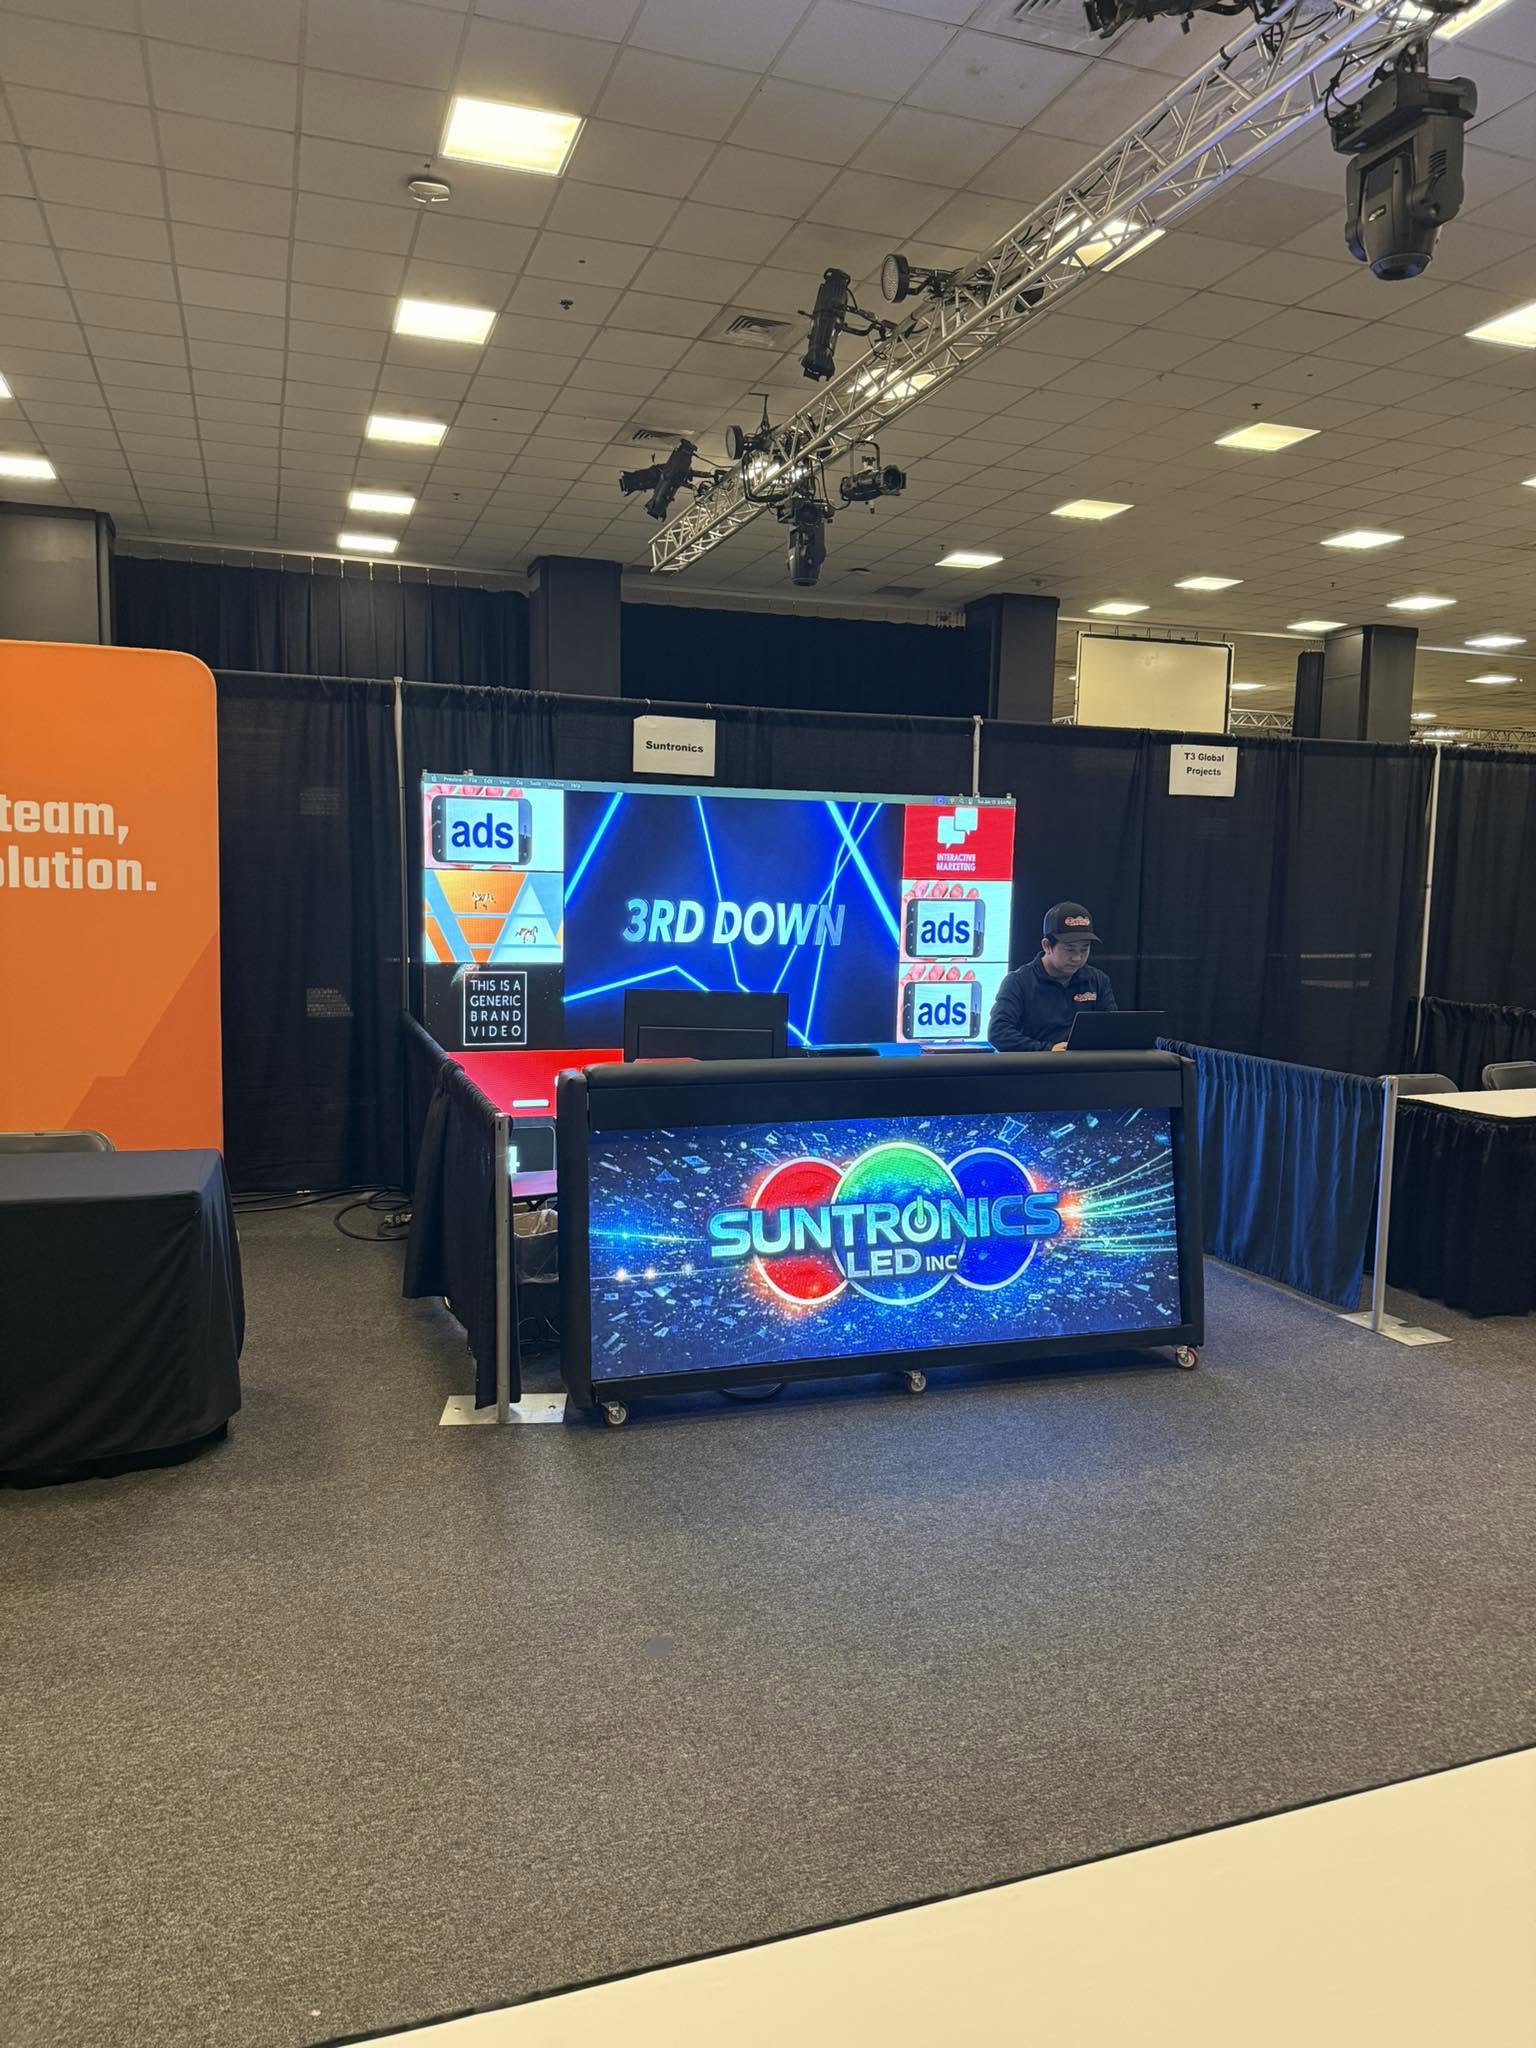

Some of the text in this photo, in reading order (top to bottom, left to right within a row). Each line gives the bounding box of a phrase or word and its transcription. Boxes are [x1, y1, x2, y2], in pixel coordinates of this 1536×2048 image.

[645, 740, 704, 753] Suntronics
[1184, 752, 1225, 762] T3 Global
[1186, 766, 1222, 776] Projects
[0, 794, 129, 845] team,
[451, 813, 514, 849] ads
[936, 853, 976, 862] INTERACTIVE
[0, 845, 157, 891] lution.
[936, 862, 977, 872] MARKETING
[622, 898, 846, 946] 3RD DOWN
[920, 912, 970, 944] ads
[470, 980, 521, 991] THIS IS A
[470, 995, 521, 1007] GENERIC
[470, 1010, 521, 1022] BRAND
[918, 994, 967, 1026] ads
[470, 1025, 521, 1037] VIDEO
[709, 1192, 1062, 1258] SUNTRONICS
[846, 1249, 958, 1279] LED INC
